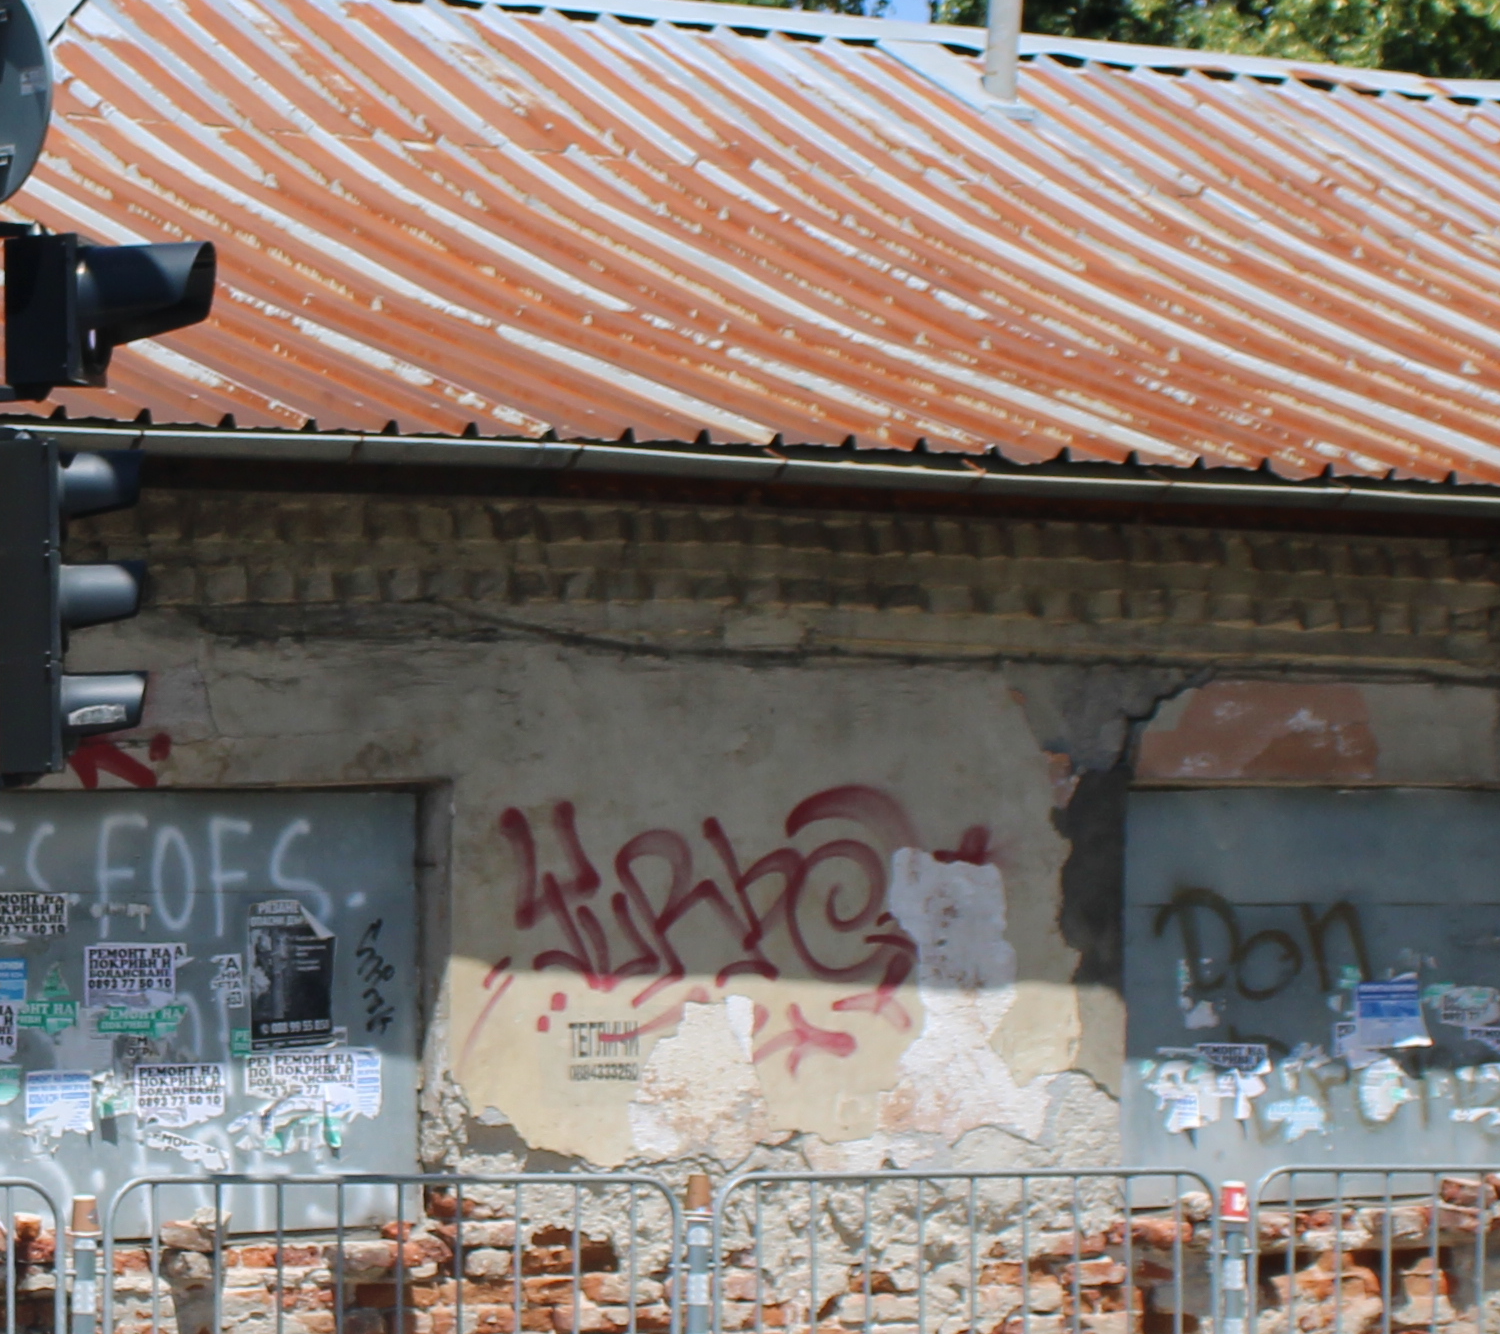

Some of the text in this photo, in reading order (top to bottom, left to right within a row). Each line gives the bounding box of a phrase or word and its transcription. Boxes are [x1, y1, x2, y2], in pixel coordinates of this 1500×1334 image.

[44, 894, 65, 905] НА
[88, 948, 147, 959] РЕМОНТ
[152, 948, 171, 959] НА
[89, 958, 159, 970] ПОКРИВИ
[121, 978, 135, 988] 77
[139, 978, 153, 988] 50
[158, 978, 172, 988] 10
[53, 1003, 75, 1015] НА
[0, 1036, 13, 1046] 10
[274, 1054, 354, 1066] РЕМОНТ НА
[139, 1066, 221, 1078] РЕМОНТ НА
[274, 1066, 341, 1075] ПОКРИВИ
[139, 1077, 204, 1087] ПОКРИВИ
[138, 1095, 221, 1108] 0893 77 50 10
